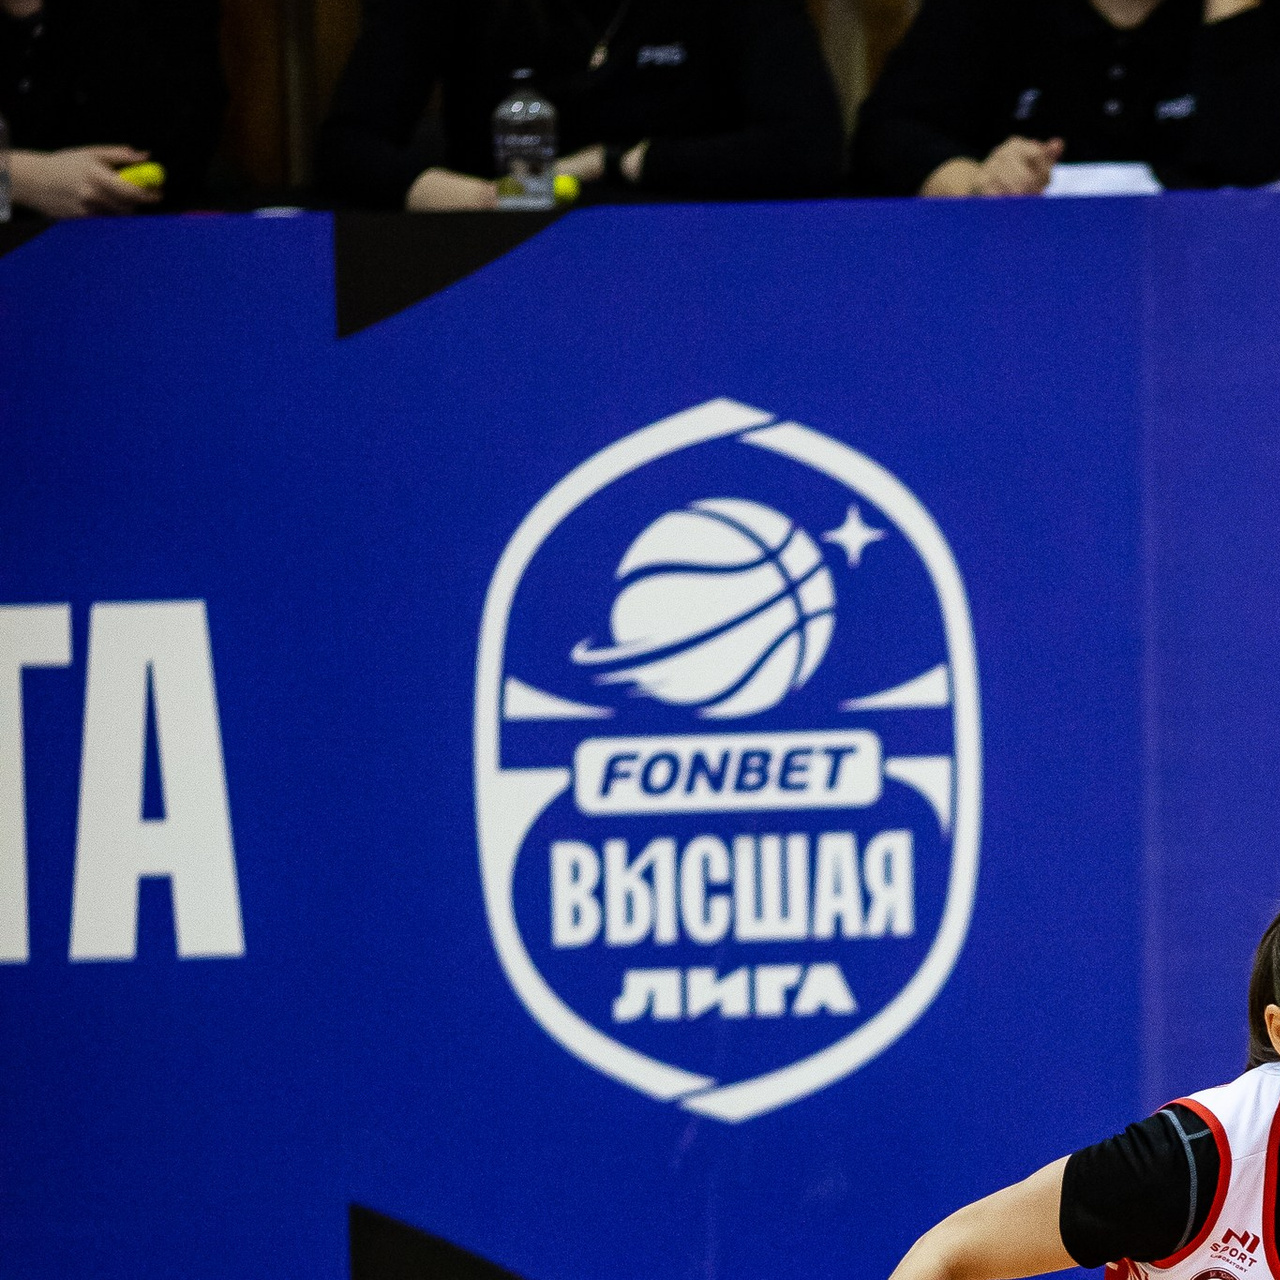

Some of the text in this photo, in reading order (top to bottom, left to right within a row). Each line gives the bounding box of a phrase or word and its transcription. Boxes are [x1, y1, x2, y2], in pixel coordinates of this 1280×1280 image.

[600, 743, 858, 798] FONBET
[549, 828, 916, 949] ВЫСШАЯ
[611, 961, 860, 1024] ЛИГА
[1210, 1242, 1257, 1267] SPORT
